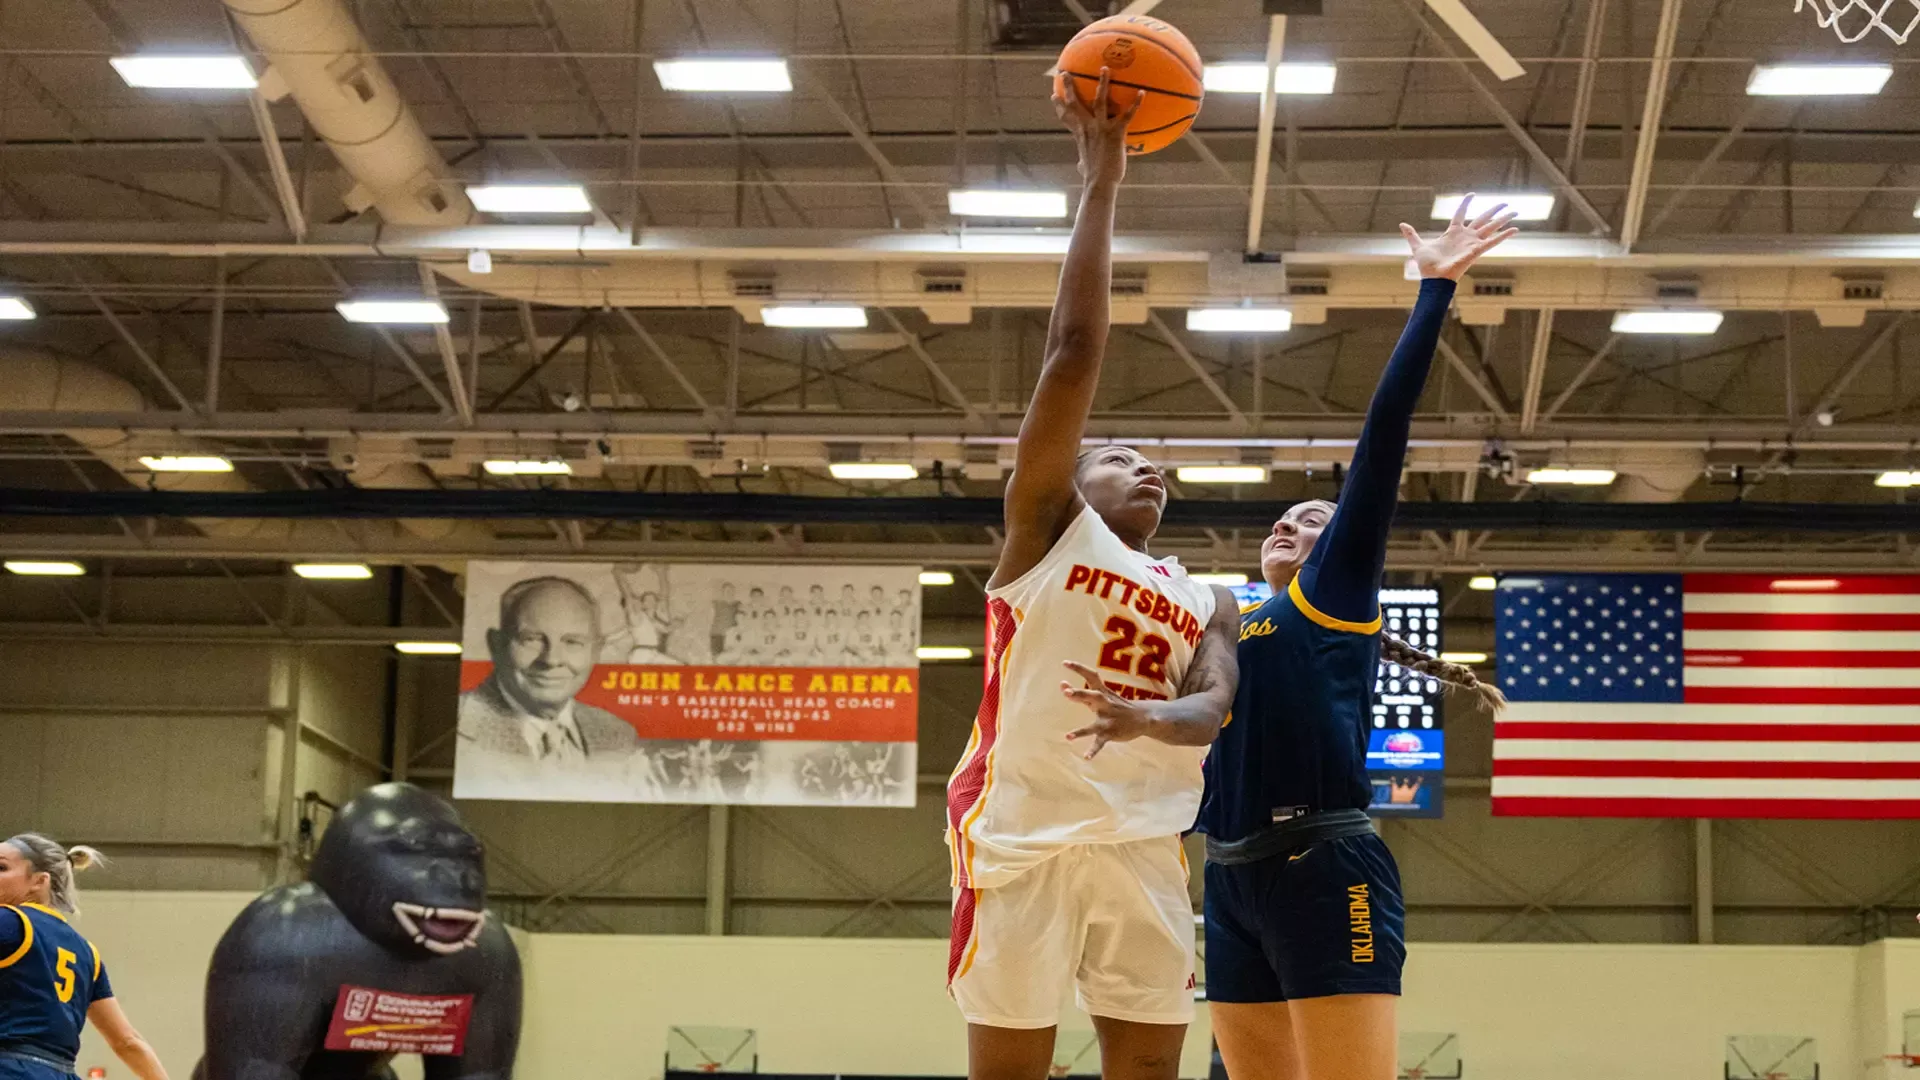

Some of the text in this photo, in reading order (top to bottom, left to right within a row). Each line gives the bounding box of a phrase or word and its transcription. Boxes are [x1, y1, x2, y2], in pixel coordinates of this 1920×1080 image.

[1098, 614, 1171, 686] 22
[601, 671, 913, 693] JOHN LANCE ARENA
[617, 694, 896, 709] MEN'S BASKETBALL HEAD COACH
[752, 722, 796, 733] WINS
[1347, 883, 1375, 963] OKLAHOMA
[53, 946, 77, 1003] 5
